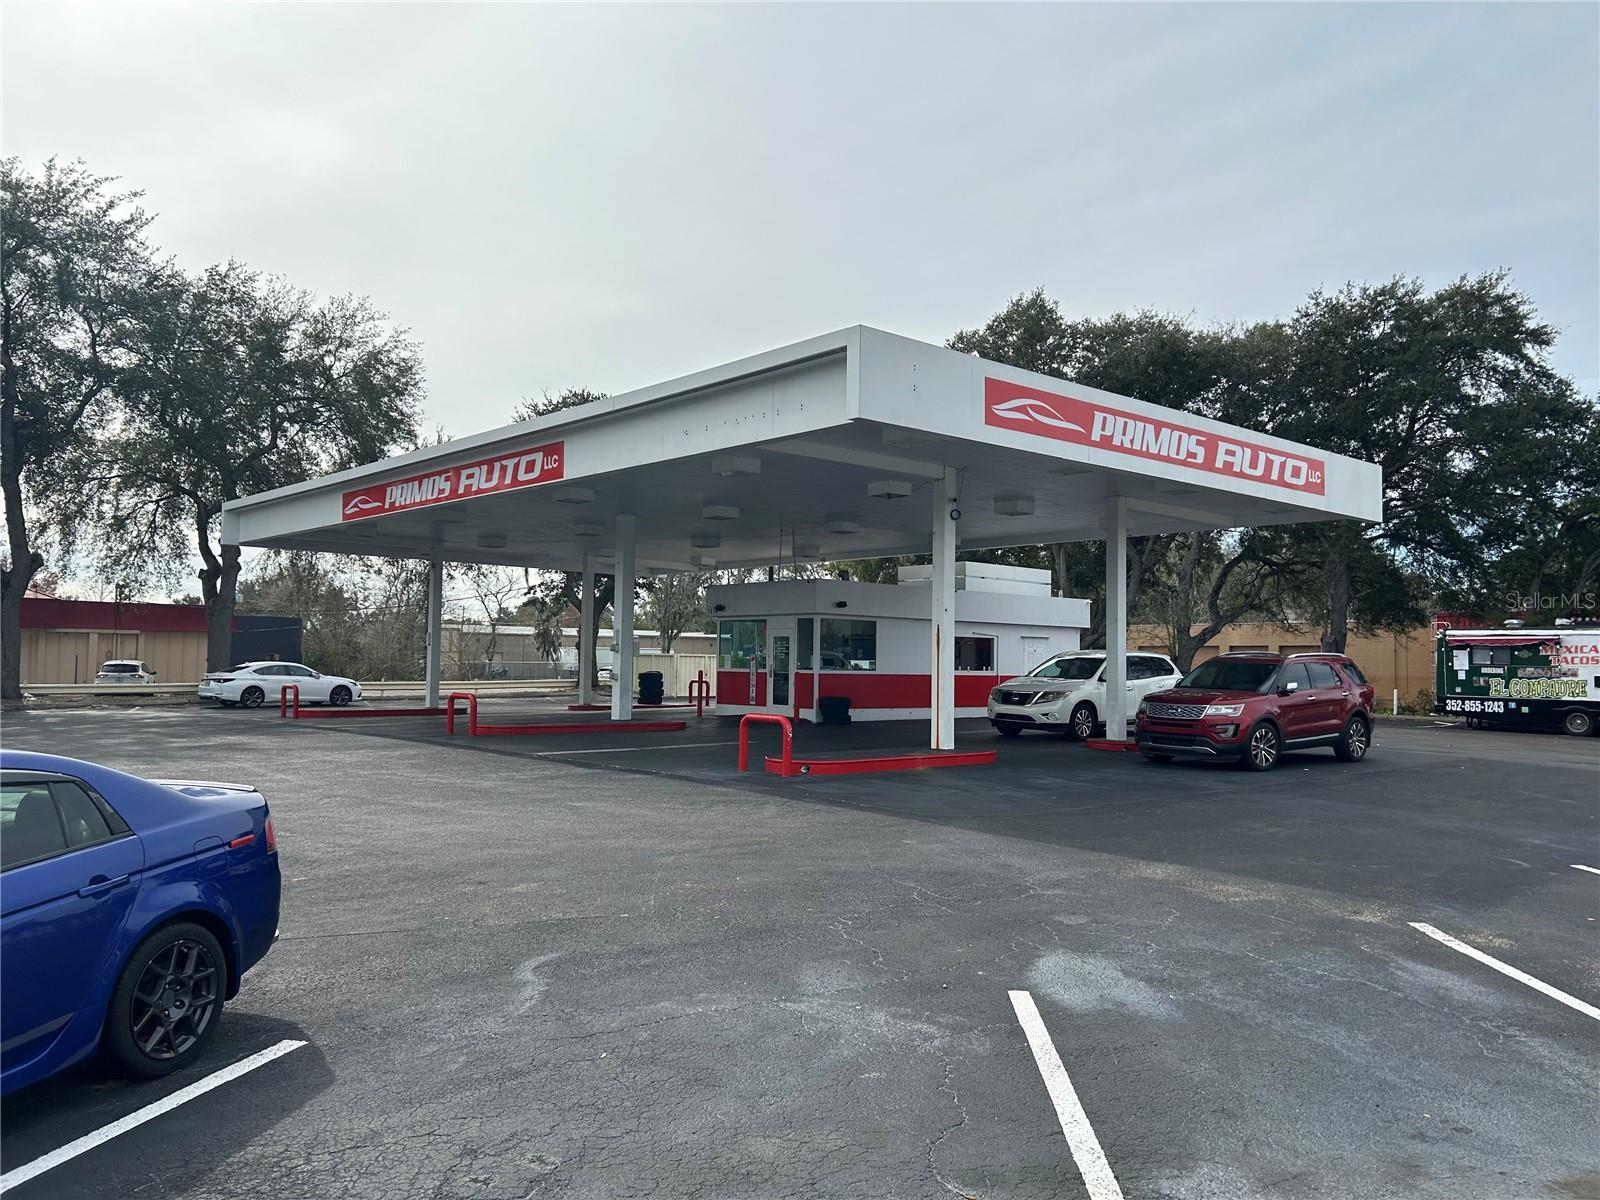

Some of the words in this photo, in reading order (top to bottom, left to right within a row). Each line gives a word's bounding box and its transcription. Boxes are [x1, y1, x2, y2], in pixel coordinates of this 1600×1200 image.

[1091, 411, 1207, 463] PRIMOS
[1215, 441, 1307, 486] AUTO
[1308, 469, 1321, 484] LLC
[385, 472, 453, 509] PRIMOS
[458, 451, 543, 494] AUTO
[544, 455, 559, 470] LLC
[1549, 656, 1600, 665] TACOS
[1489, 678, 1509, 696] EL
[1509, 678, 1588, 698] COMPADRE
[1446, 699, 1504, 713] 352-855-1243
